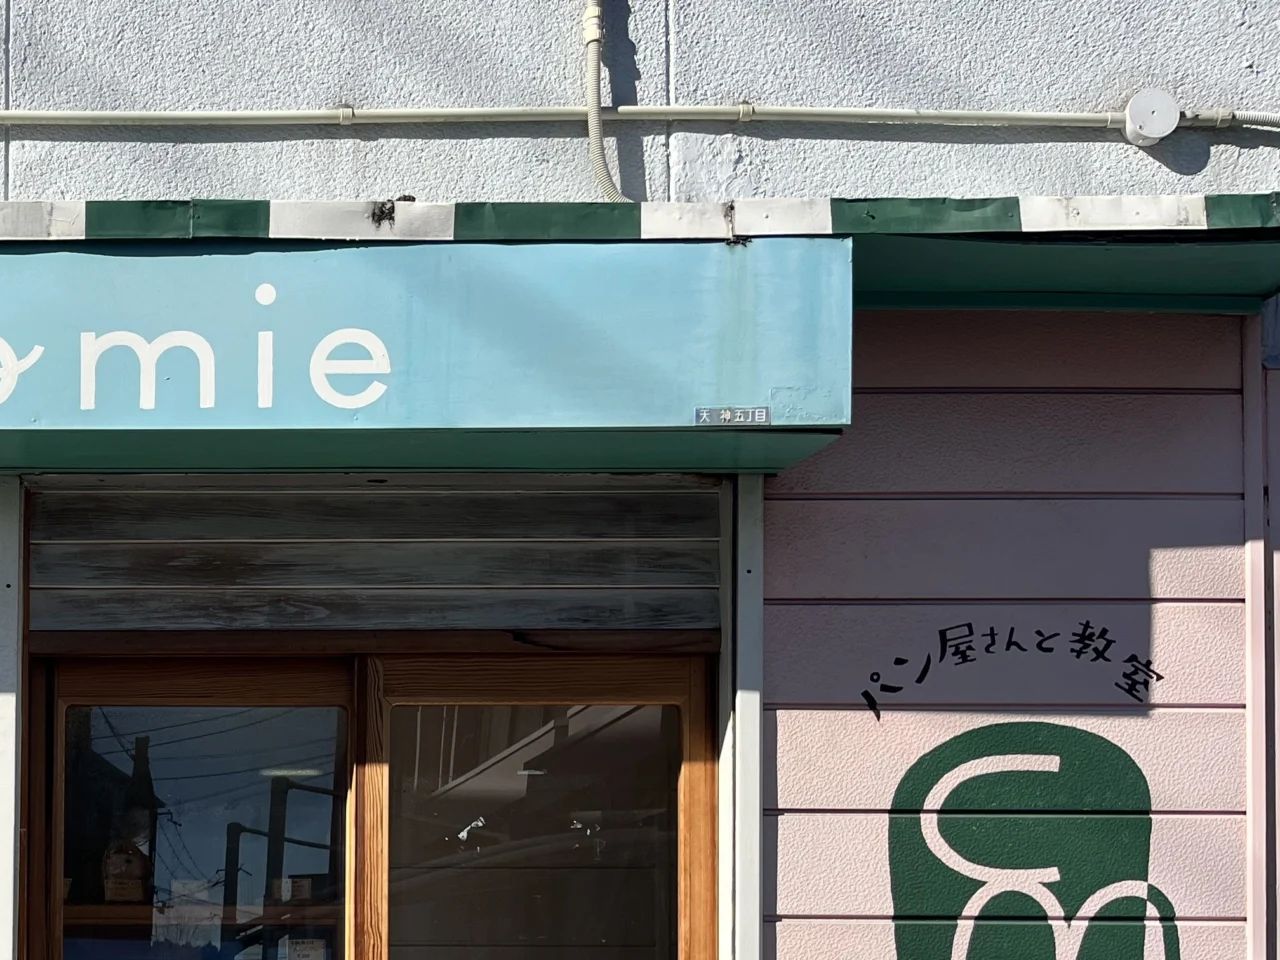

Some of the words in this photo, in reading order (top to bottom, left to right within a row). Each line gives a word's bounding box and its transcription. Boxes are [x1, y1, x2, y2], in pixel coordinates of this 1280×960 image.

[80, 283, 391, 410] mie
[861, 620, 1165, 722] パン屋さんと教室
